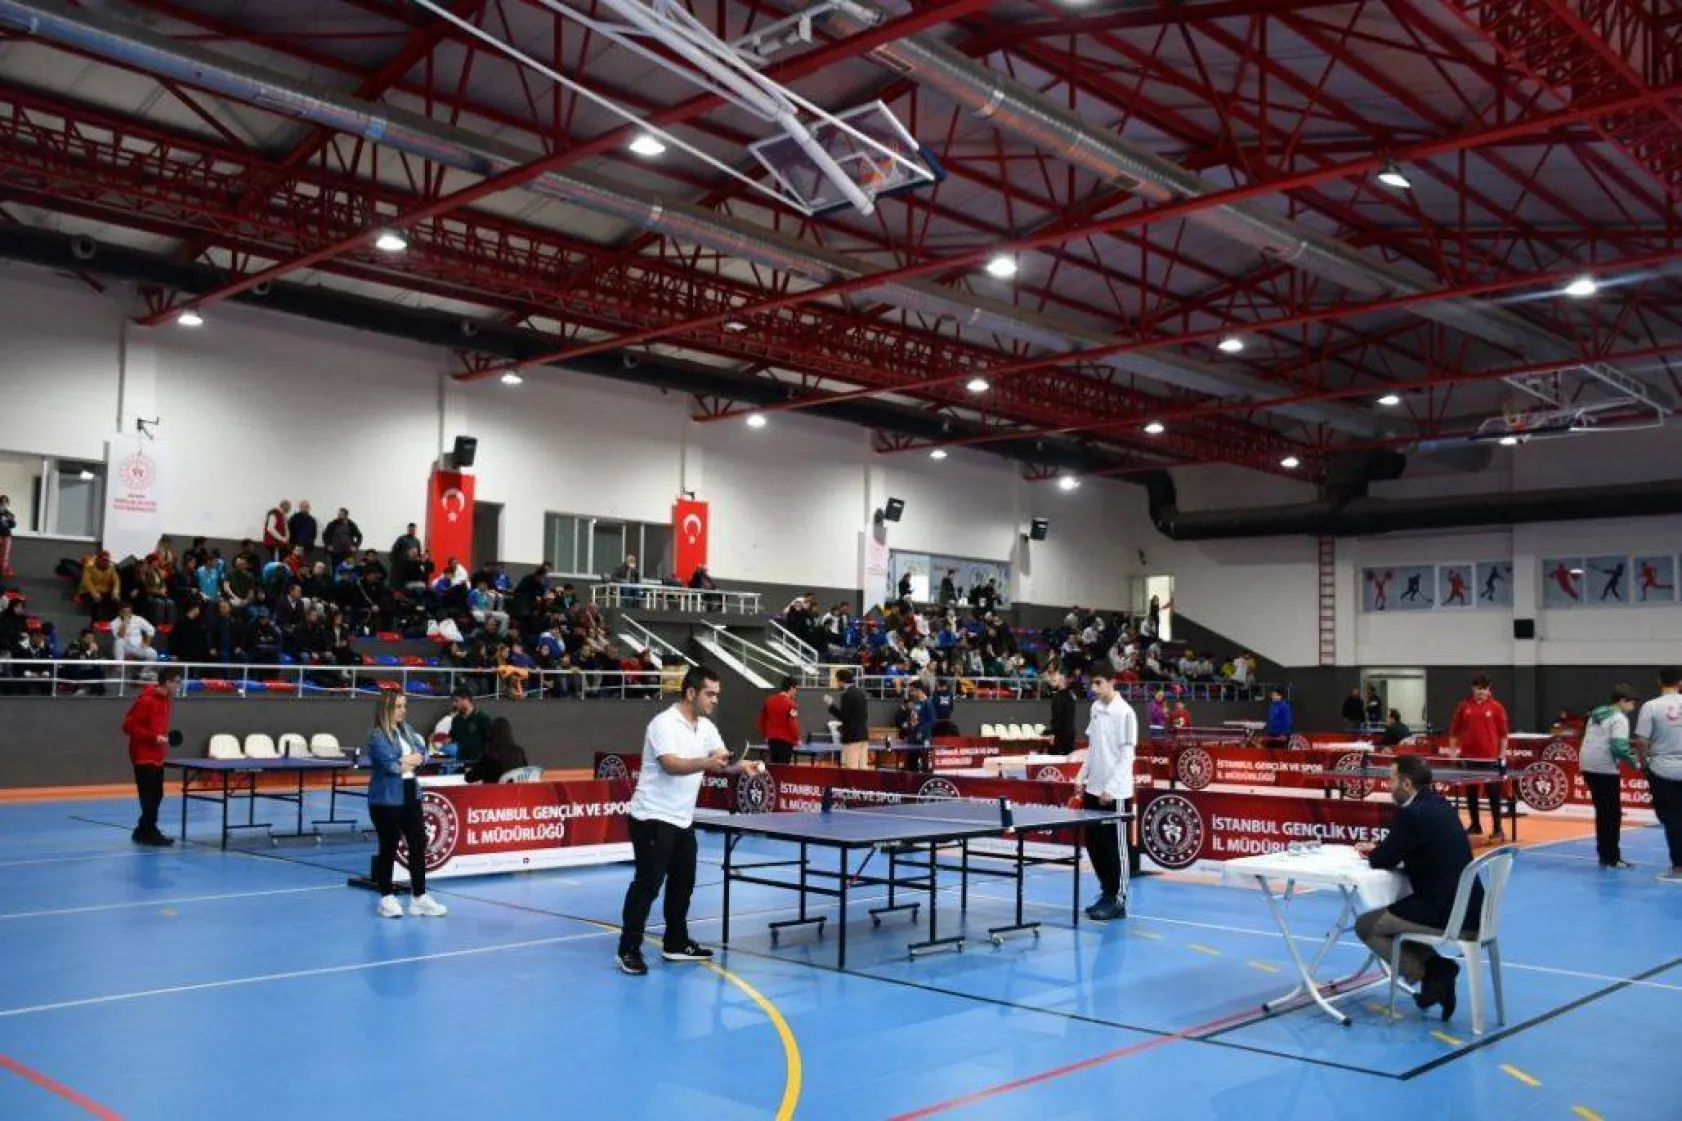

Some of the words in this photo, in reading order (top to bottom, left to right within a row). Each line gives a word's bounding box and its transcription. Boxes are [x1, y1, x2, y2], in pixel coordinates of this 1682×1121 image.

[780, 781, 821, 796] İSTANBUL
[467, 807, 530, 824] İSTANBUL
[532, 801, 584, 821] GENÇLİK
[586, 803, 601, 817] VE
[467, 828, 479, 844] İL
[481, 823, 565, 844] MÜDÜRLÜĞÜ
[1212, 814, 1279, 834] İSTANBUL
[1282, 821, 1346, 841] GENÇLİK
[1347, 827, 1369, 841] VE
[1370, 828, 1390, 842] SP
[1212, 835, 1225, 851] İL
